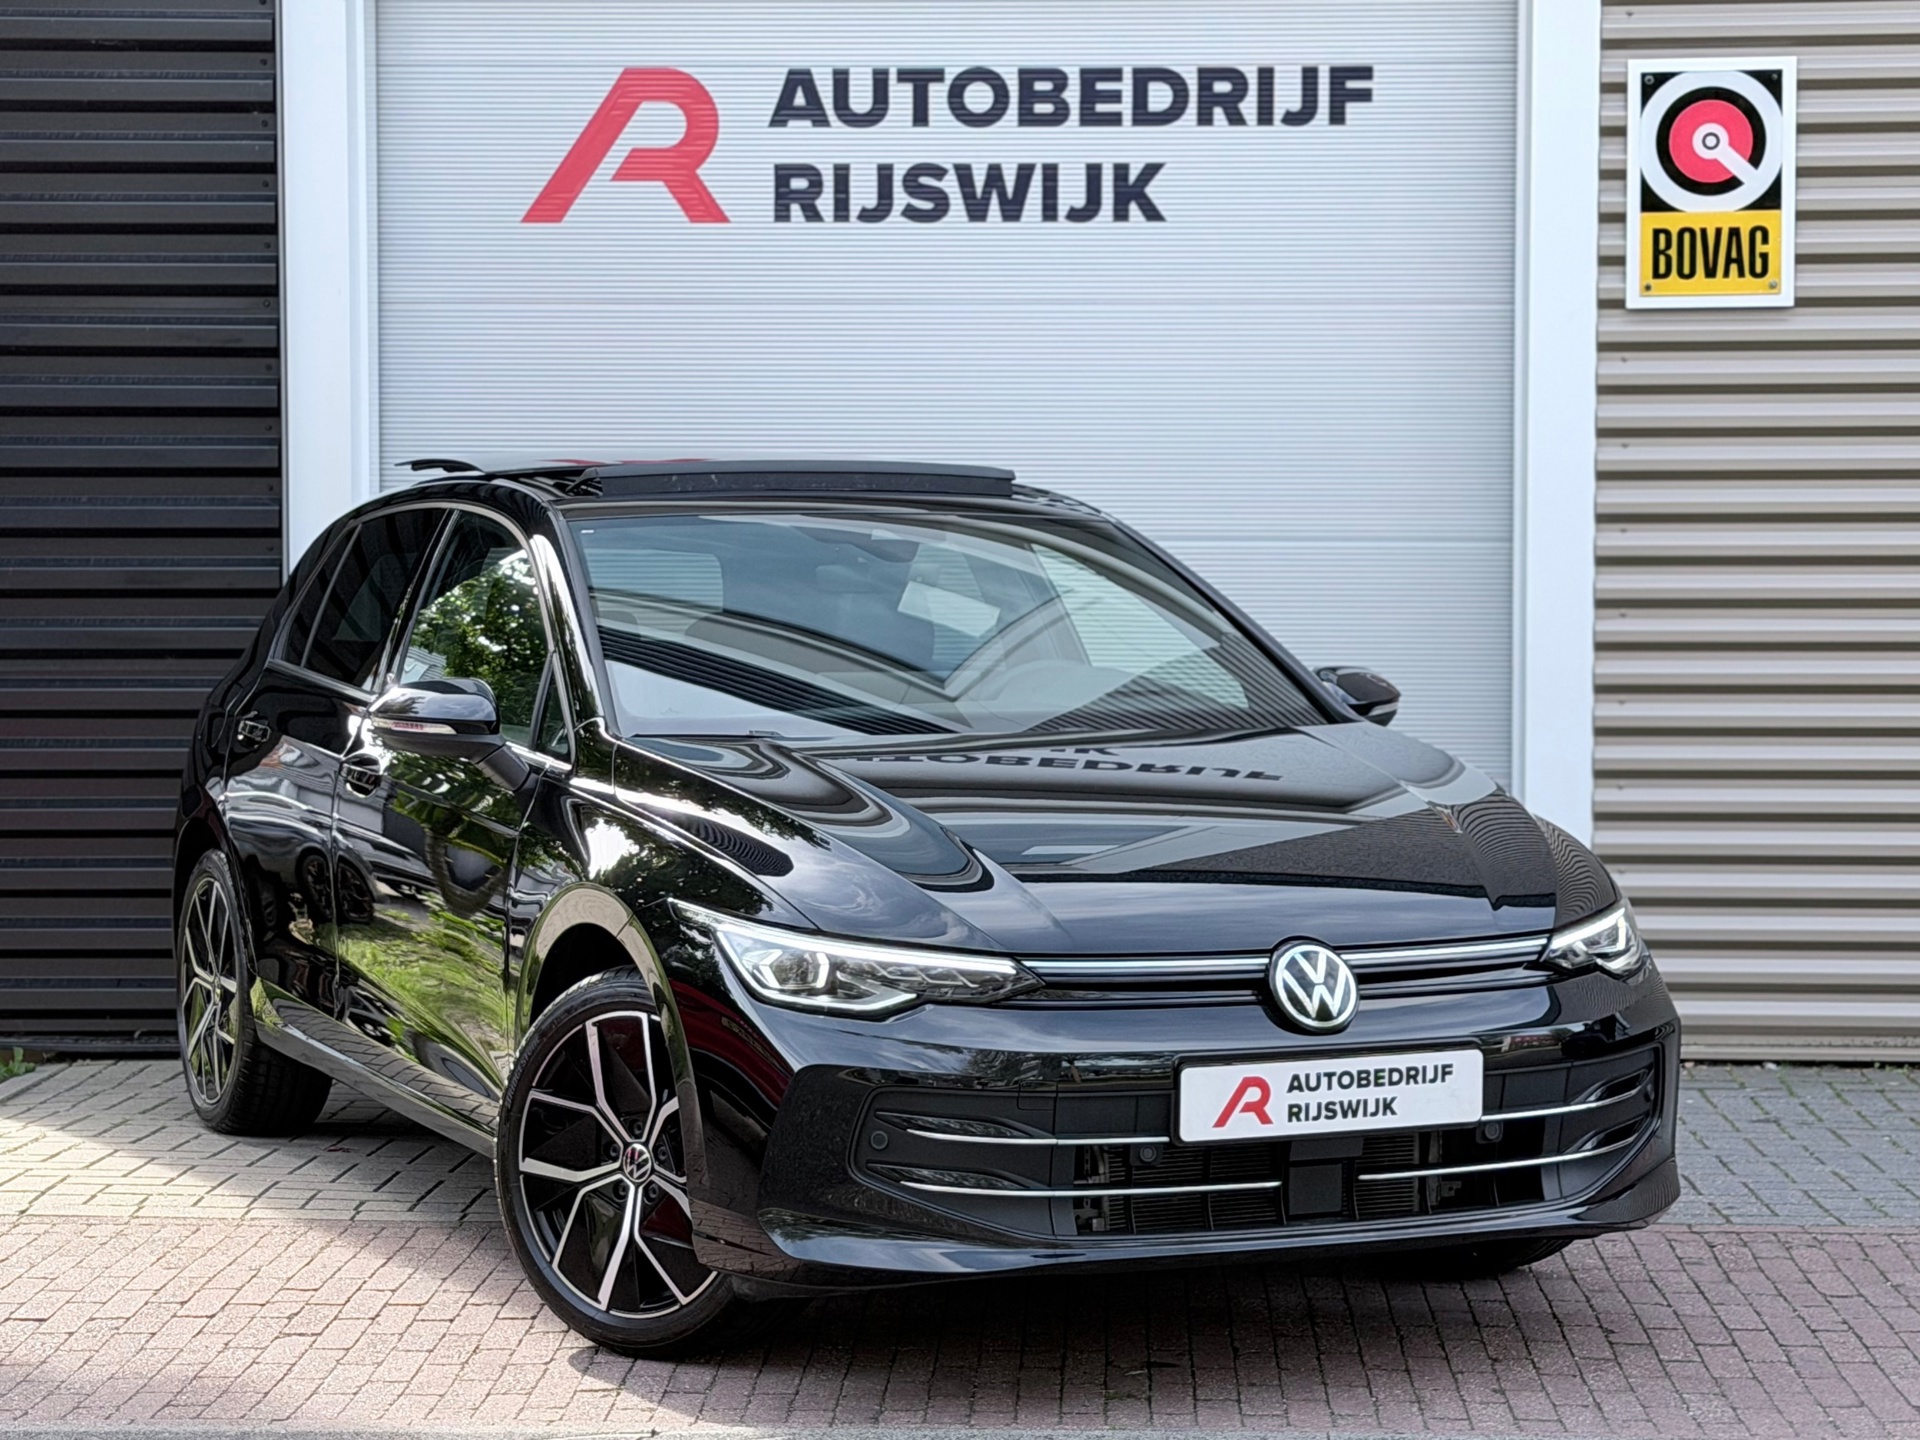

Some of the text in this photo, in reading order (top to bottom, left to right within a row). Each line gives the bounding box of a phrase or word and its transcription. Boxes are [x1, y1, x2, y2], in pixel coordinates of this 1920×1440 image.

[768, 66, 1374, 128] AUTOBEDRIJF
[773, 163, 1167, 223] RIJSWIJK
[1652, 225, 1769, 280] BOVAG
[1287, 1063, 1454, 1094] AUTOBEDRIJF
[1287, 1096, 1398, 1123] RIJSWIJK
